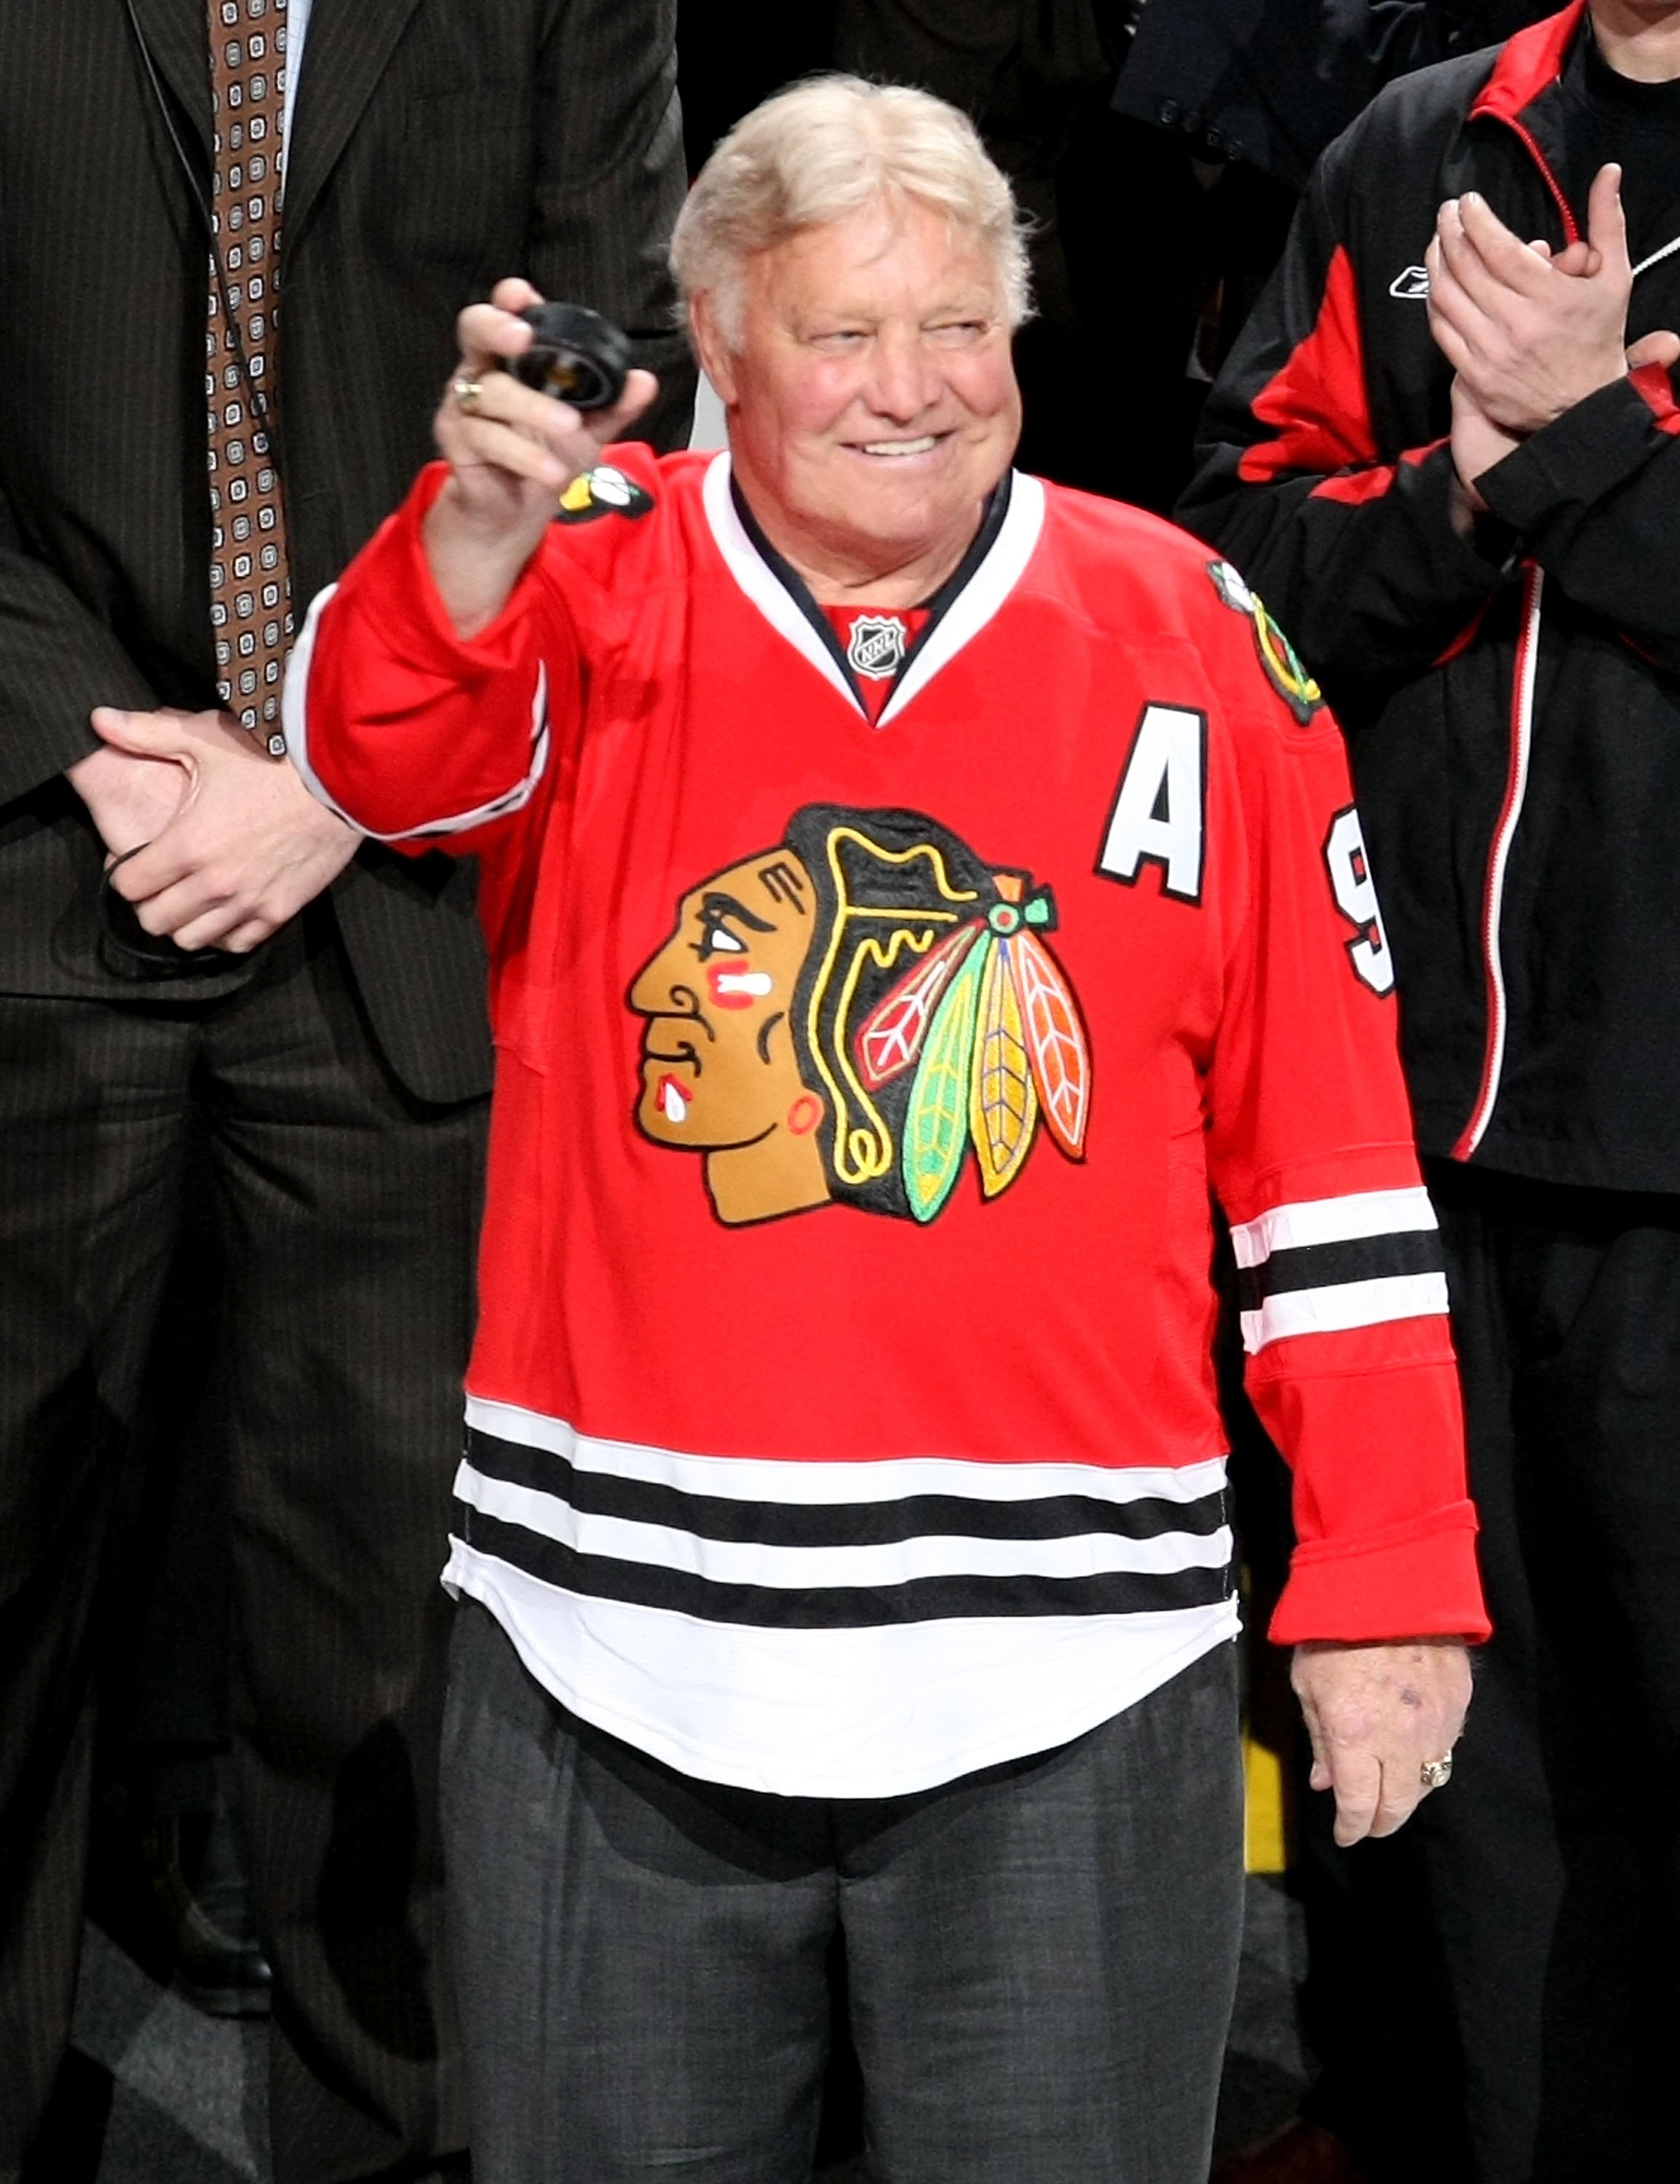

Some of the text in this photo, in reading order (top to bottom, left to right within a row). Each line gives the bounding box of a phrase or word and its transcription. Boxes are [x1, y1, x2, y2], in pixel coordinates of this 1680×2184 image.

[861, 630, 895, 663] NHL
[1095, 703, 1207, 906] A
[1324, 805, 1395, 997] 9
